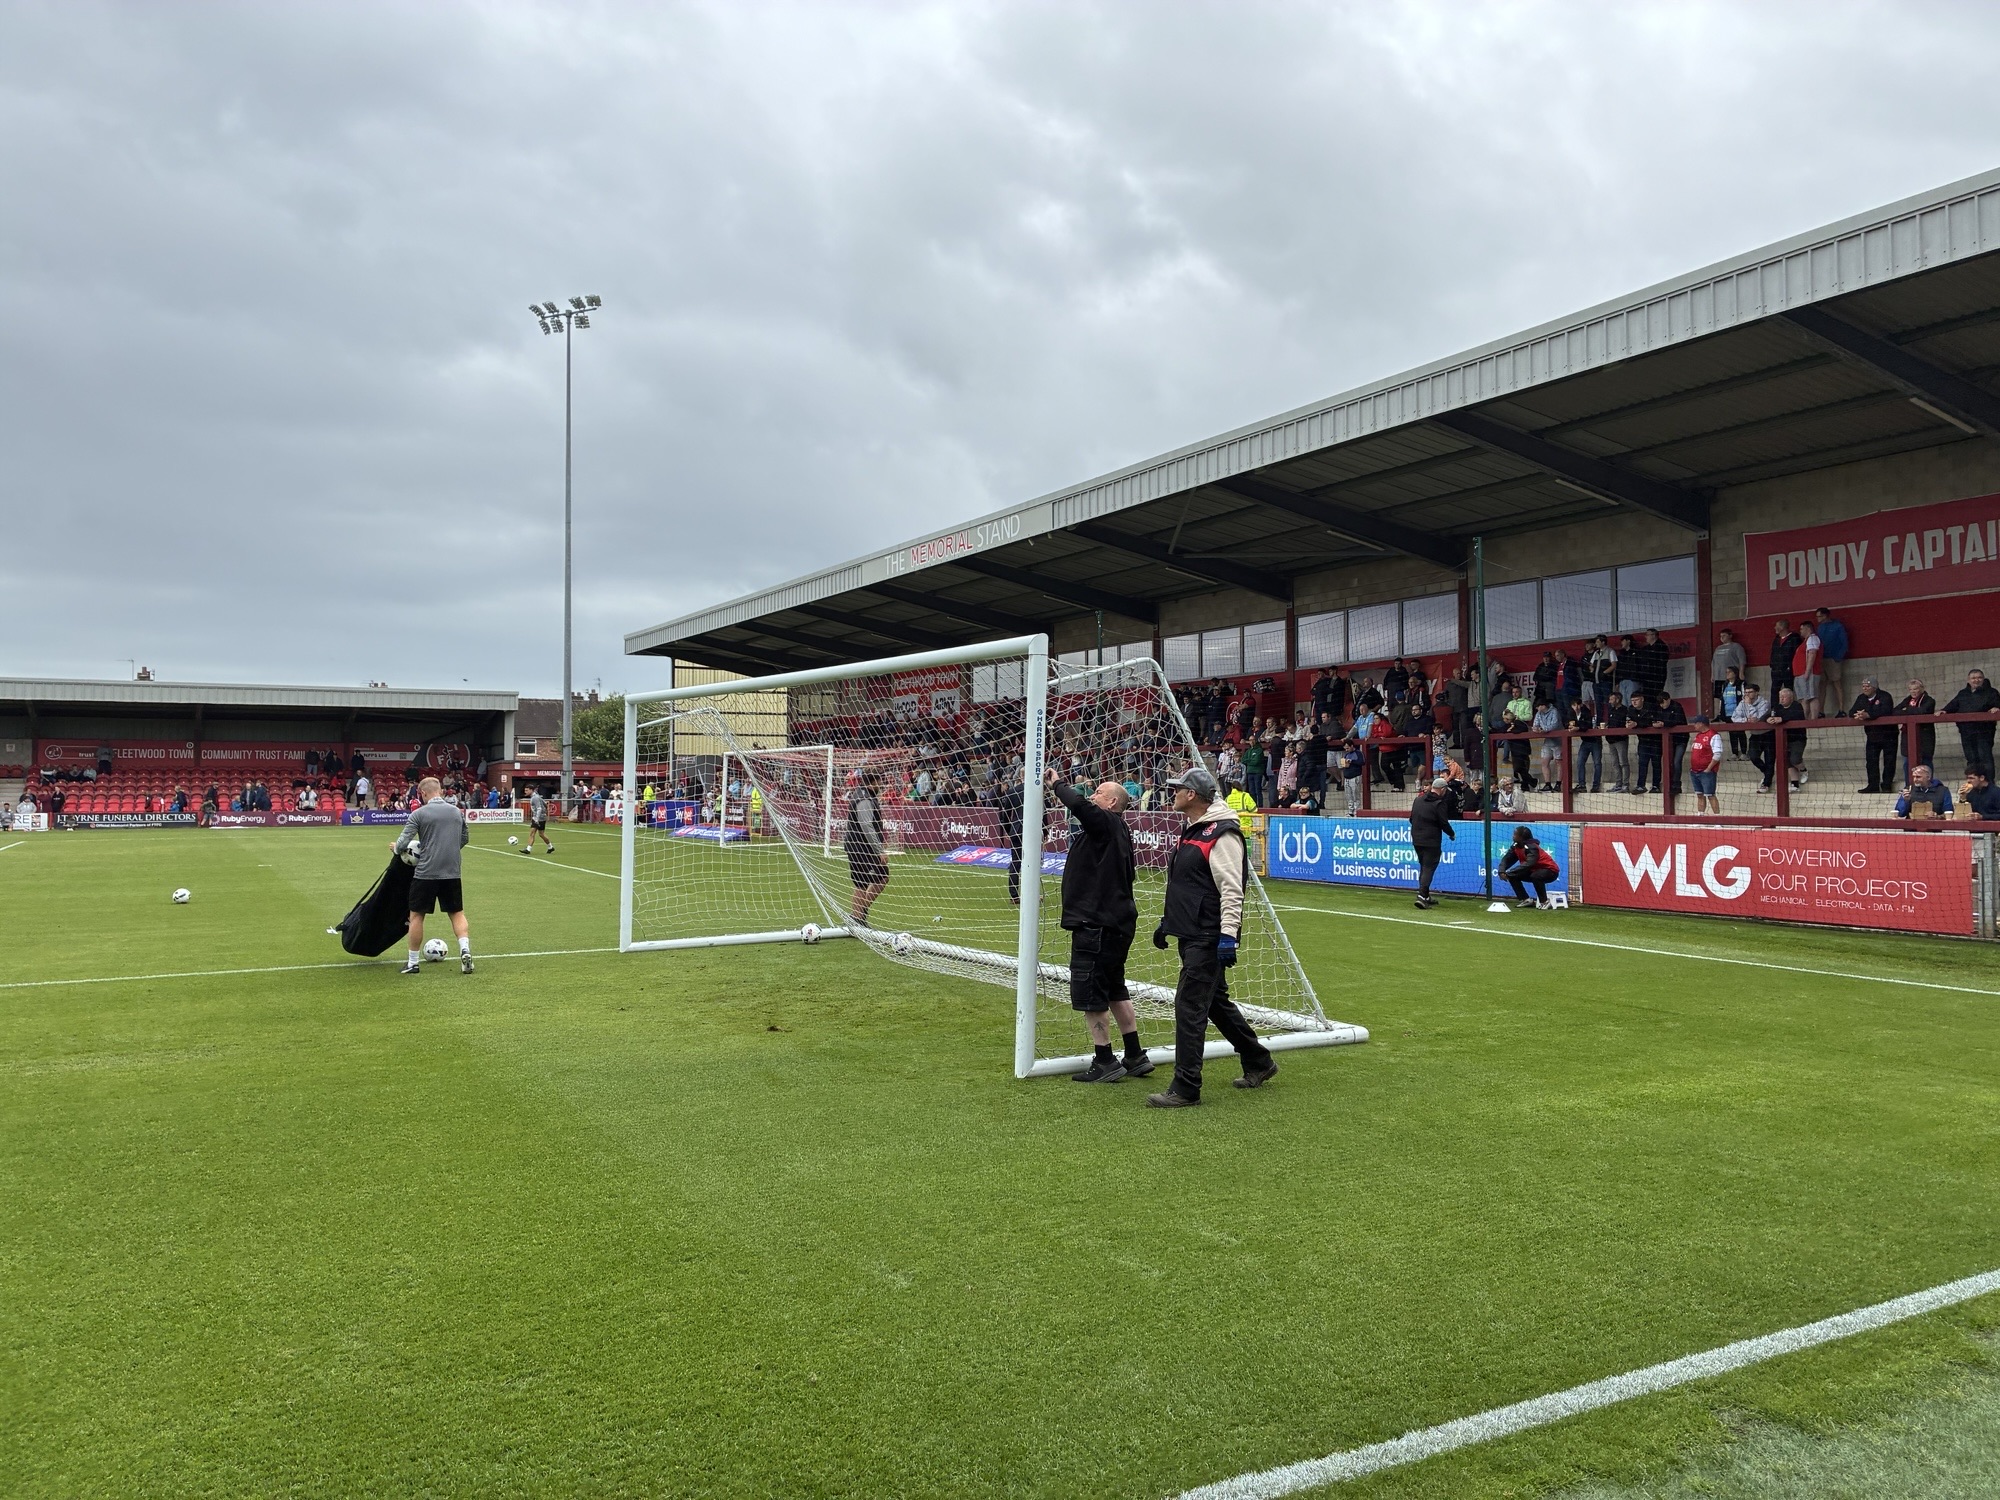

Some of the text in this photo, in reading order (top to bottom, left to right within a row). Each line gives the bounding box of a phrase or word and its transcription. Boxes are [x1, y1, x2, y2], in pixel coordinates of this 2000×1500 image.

[885, 515, 1021, 576] THE MEMORIAL STAND
[1768, 519, 2000, 590] PONDY, CAPTAI
[937, 670, 959, 685] TOWN
[934, 696, 956, 711] ARMY
[168, 748, 194, 759] TOWN
[201, 749, 253, 760] COMMUNITY
[255, 750, 281, 760] TRUST
[283, 750, 306, 760] FAMIL
[74, 814, 99, 822] YRNE
[102, 814, 143, 822] FUNERAL
[145, 813, 197, 822] DIRECTORS
[221, 815, 266, 824] RubyEnergy
[288, 815, 332, 823] RubyEnergy
[950, 822, 989, 838] RubyEnergy
[1133, 830, 1182, 849] RubyEner
[1333, 824, 1412, 844] Are you looki
[1279, 823, 1322, 864] lab
[1333, 843, 1364, 858] scale
[1367, 845, 1390, 860] and
[1440, 852, 1456, 864] ur
[1758, 848, 1867, 869] POWERING
[1283, 866, 1314, 874] creative
[1333, 860, 1420, 880] business onlin
[1611, 842, 1752, 900] WLG
[1758, 873, 1928, 900] YOUR PROJECTS
[1760, 895, 1808, 906] MECHANICAL
[1815, 899, 1865, 910] ELECTRICAL
[1873, 903, 1893, 912] DATA
